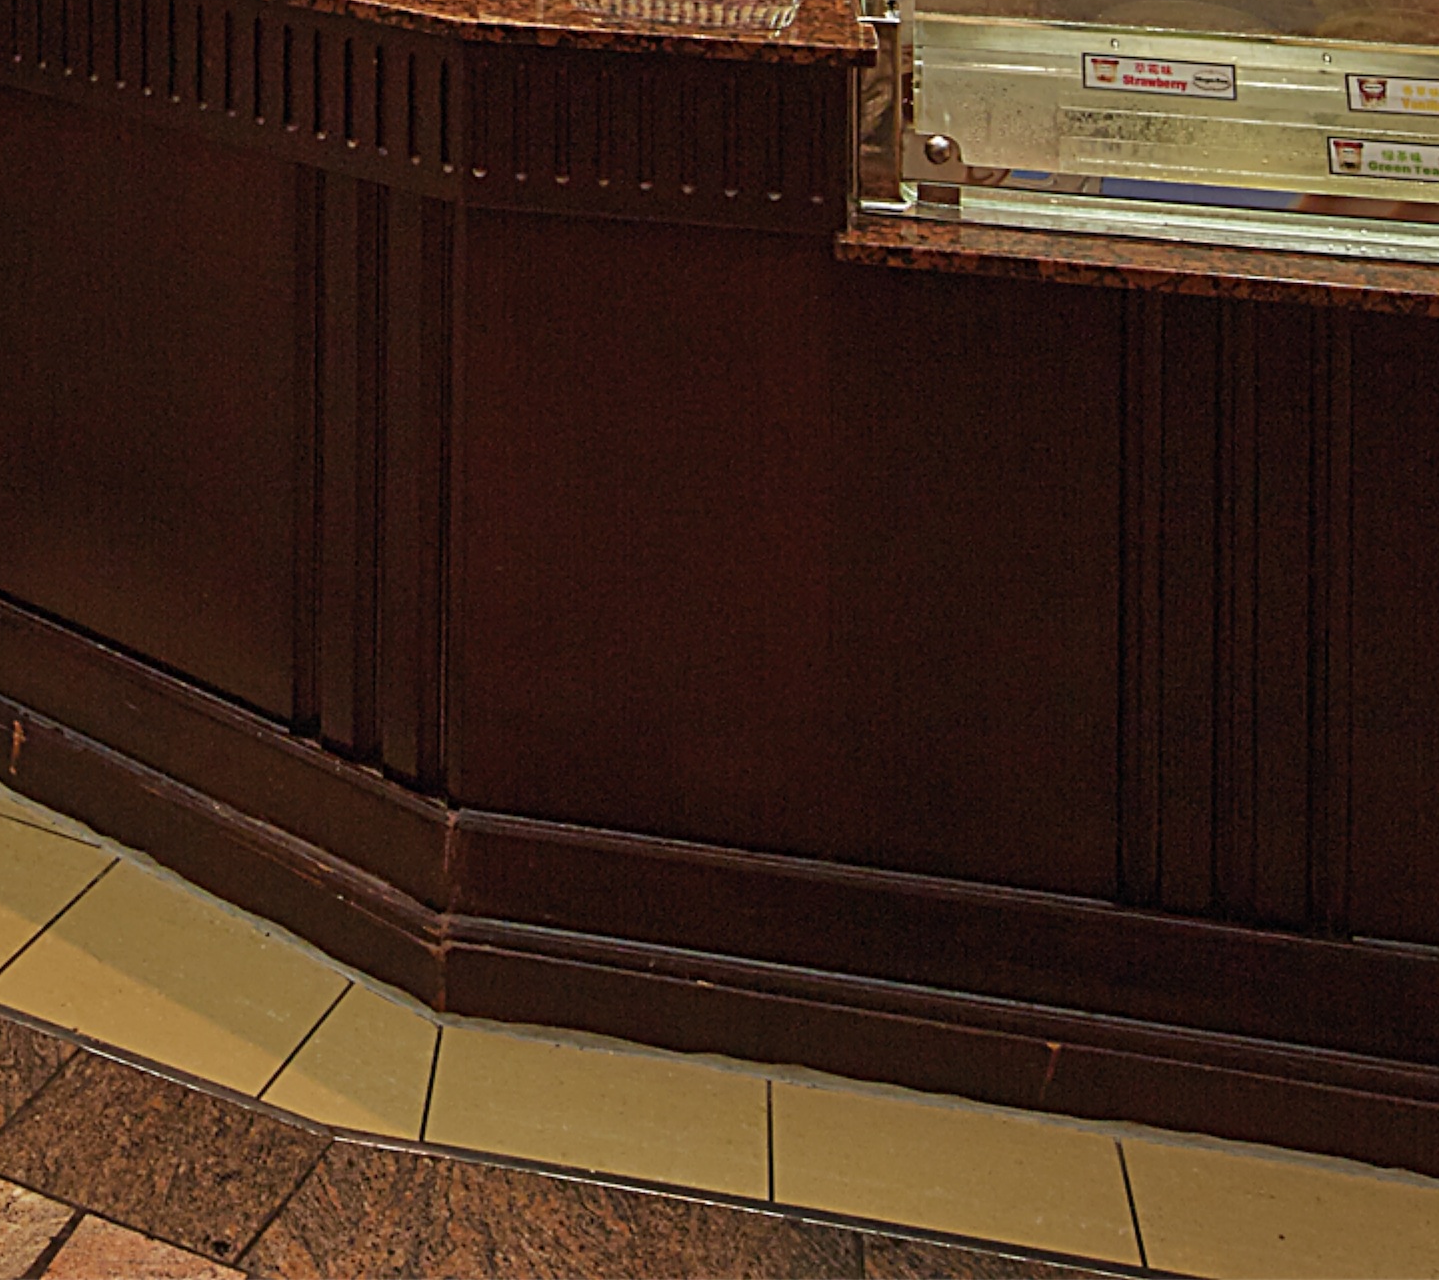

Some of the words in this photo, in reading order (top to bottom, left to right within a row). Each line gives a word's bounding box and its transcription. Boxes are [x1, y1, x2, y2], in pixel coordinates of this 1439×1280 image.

[1122, 74, 1187, 91] Strawberry
[1368, 161, 1411, 174] Green
[1415, 165, 1439, 176] Tea
